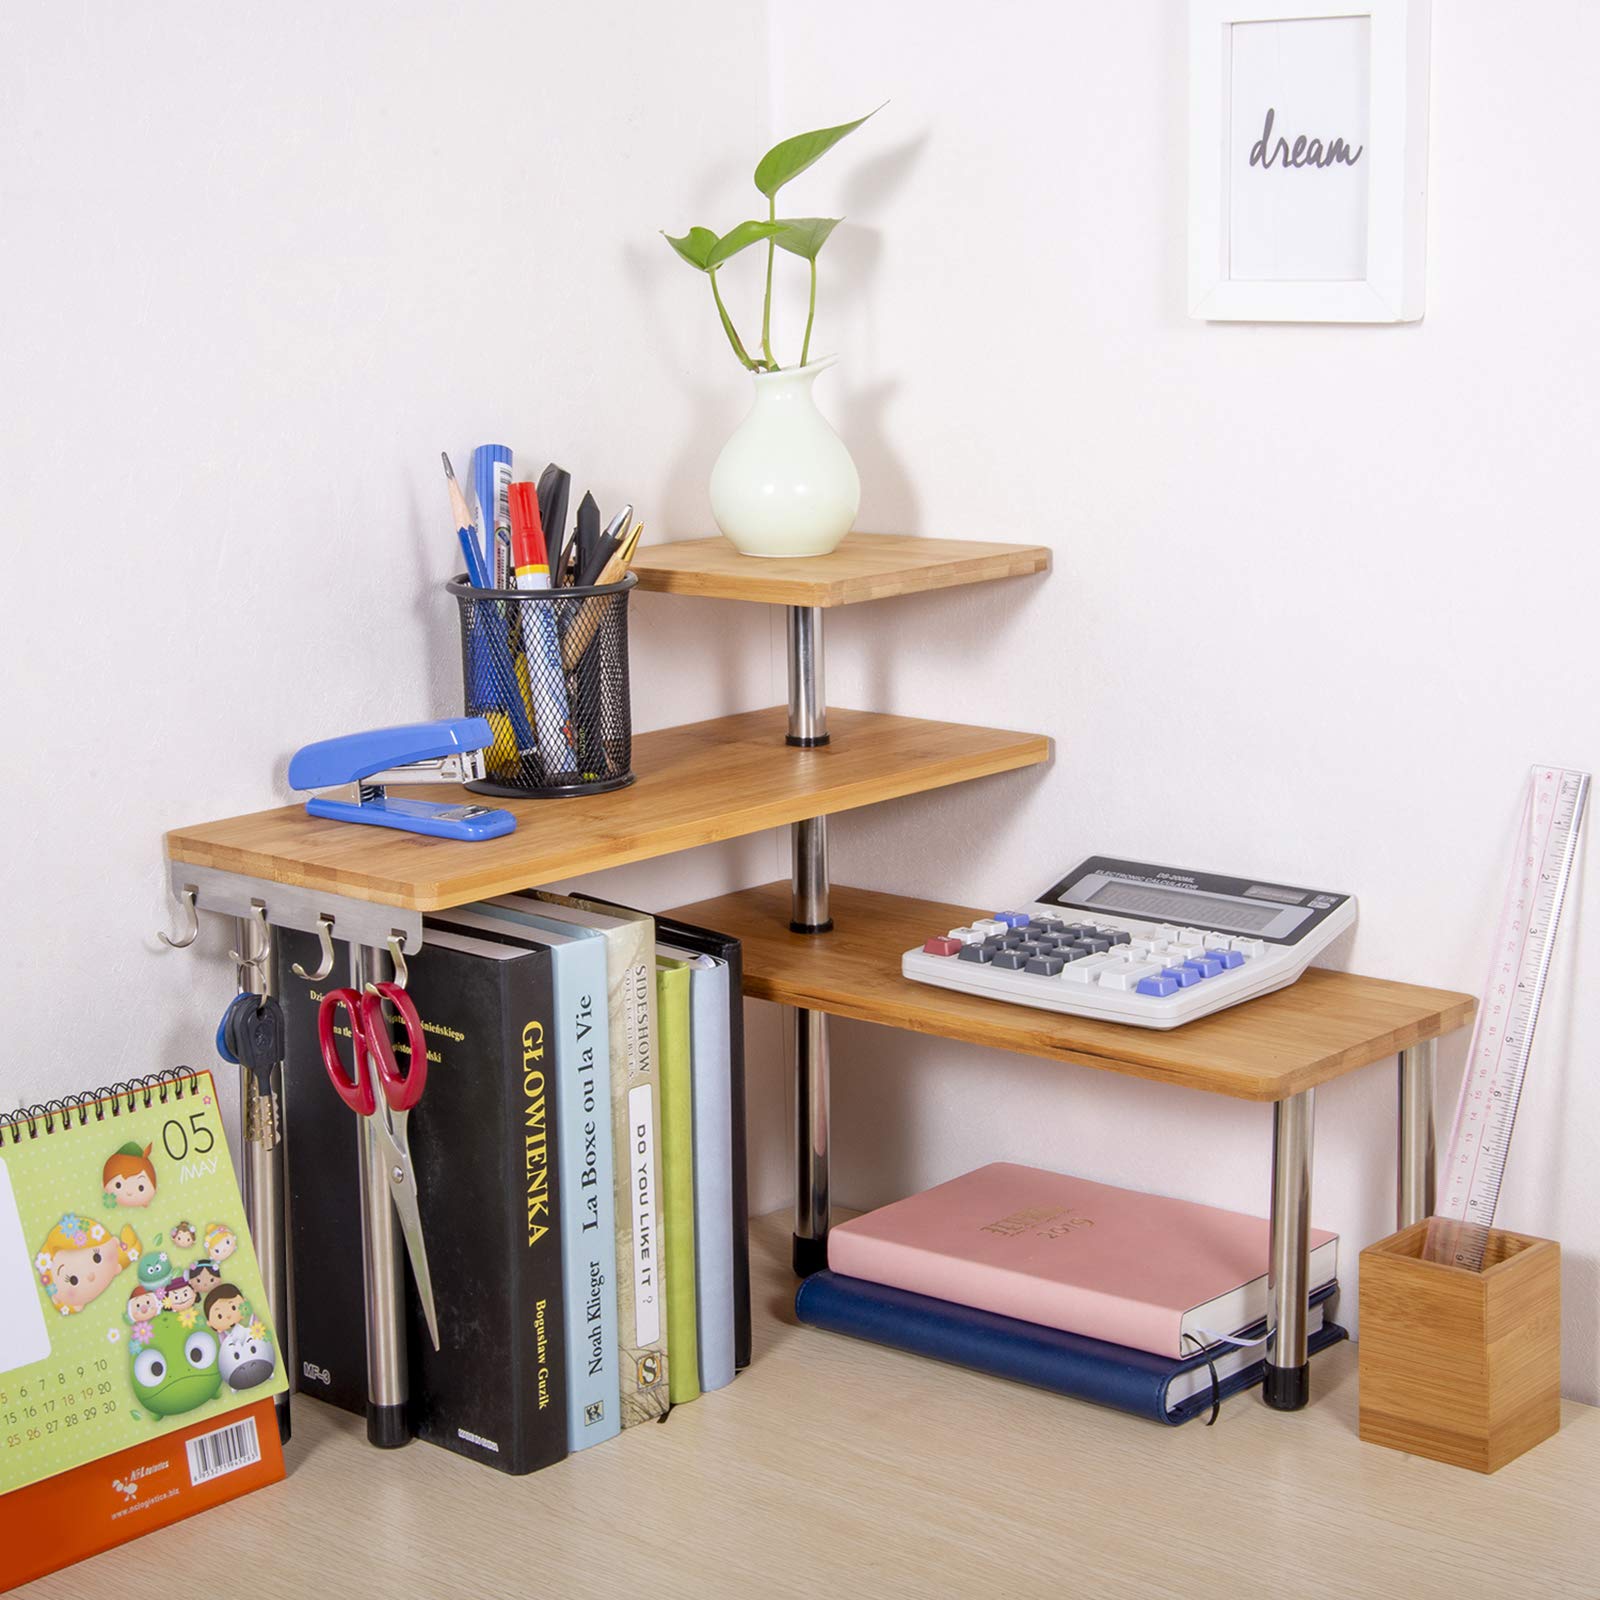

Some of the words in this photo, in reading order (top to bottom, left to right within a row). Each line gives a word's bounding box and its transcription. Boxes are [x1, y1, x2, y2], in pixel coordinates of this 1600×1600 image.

[1249, 108, 1363, 169] dream
[576, 994, 592, 1043] Vie
[635, 965, 651, 1072] SIDESHOW
[578, 1047, 594, 1073] la
[582, 1080, 595, 1112] ou
[162, 1112, 215, 1161] 05
[523, 1021, 549, 1247] GŁOWIENKA
[580, 1121, 598, 1189] Boxe
[637, 1124, 647, 1154] DO
[637, 1164, 649, 1206] YOU
[1469, 1198, 1478, 1206] 8
[582, 1196, 599, 1233] La
[639, 1213, 651, 1260] LIKE
[587, 1261, 605, 1324] Klieger
[640, 1268, 652, 1287] IT
[303, 1361, 331, 1385] MF-3
[588, 1327, 603, 1376] Noah
[20, 1385, 28, 1398] 6
[39, 1379, 45, 1391] 7
[57, 1373, 66, 1384] 8
[76, 1366, 84, 1378] 9
[94, 1359, 108, 1372] 10
[537, 1368, 548, 1410] Guzik
[3, 1412, 18, 1425] 15
[23, 1406, 37, 1418] 16
[43, 1400, 55, 1413] 17
[62, 1393, 76, 1406] 18
[81, 1387, 94, 1400] 19
[97, 1381, 112, 1395] 20
[7, 1433, 21, 1448] 25
[27, 1427, 41, 1441] 26
[45, 1420, 59, 1434] 27
[65, 1413, 79, 1427] 28
[83, 1406, 97, 1421] 29
[103, 1400, 117, 1414] 30
